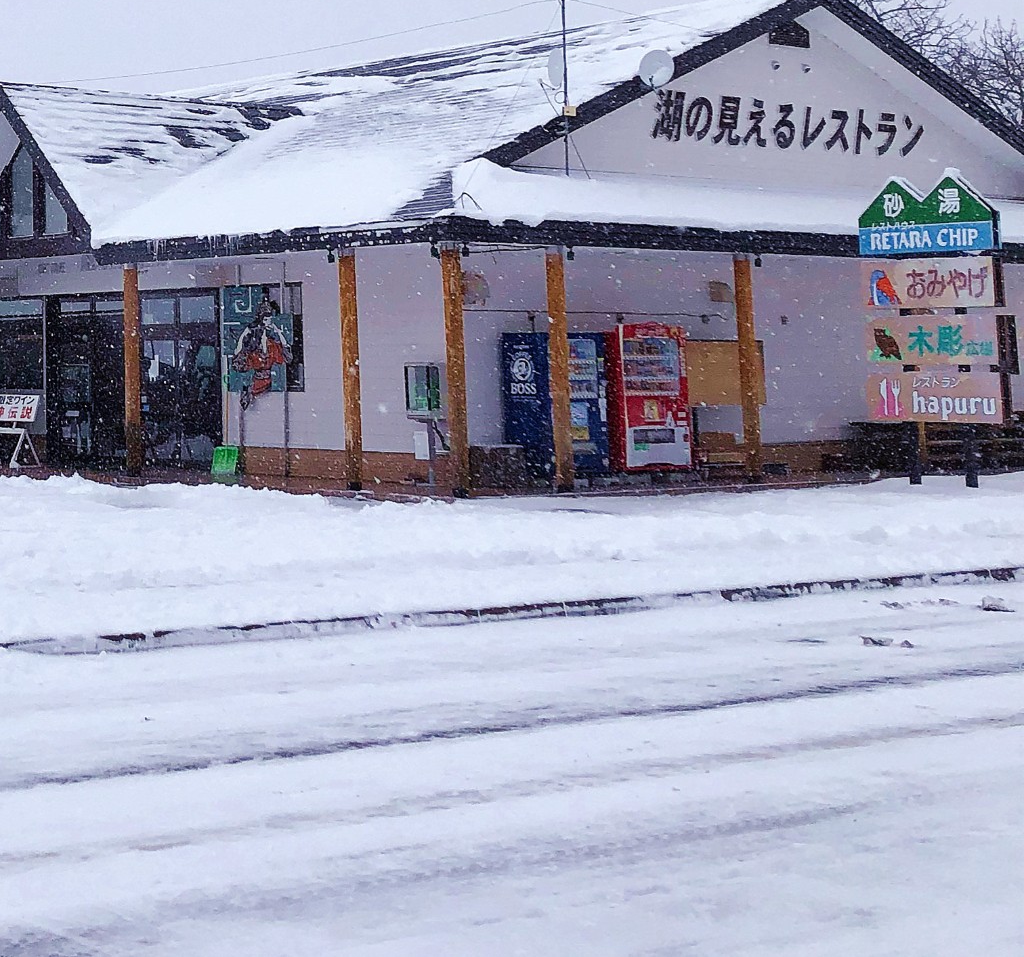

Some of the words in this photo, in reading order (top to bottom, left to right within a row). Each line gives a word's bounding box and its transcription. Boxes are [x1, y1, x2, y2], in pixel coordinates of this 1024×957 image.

[650, 89, 924, 157] 湖の見えるレストラン
[870, 230, 932, 250] RETARA
[936, 228, 979, 247] CHIP
[906, 266, 988, 299] おみやげ
[510, 382, 537, 395] BOSS
[912, 376, 961, 389] レストラン
[912, 390, 996, 421] hapuru
